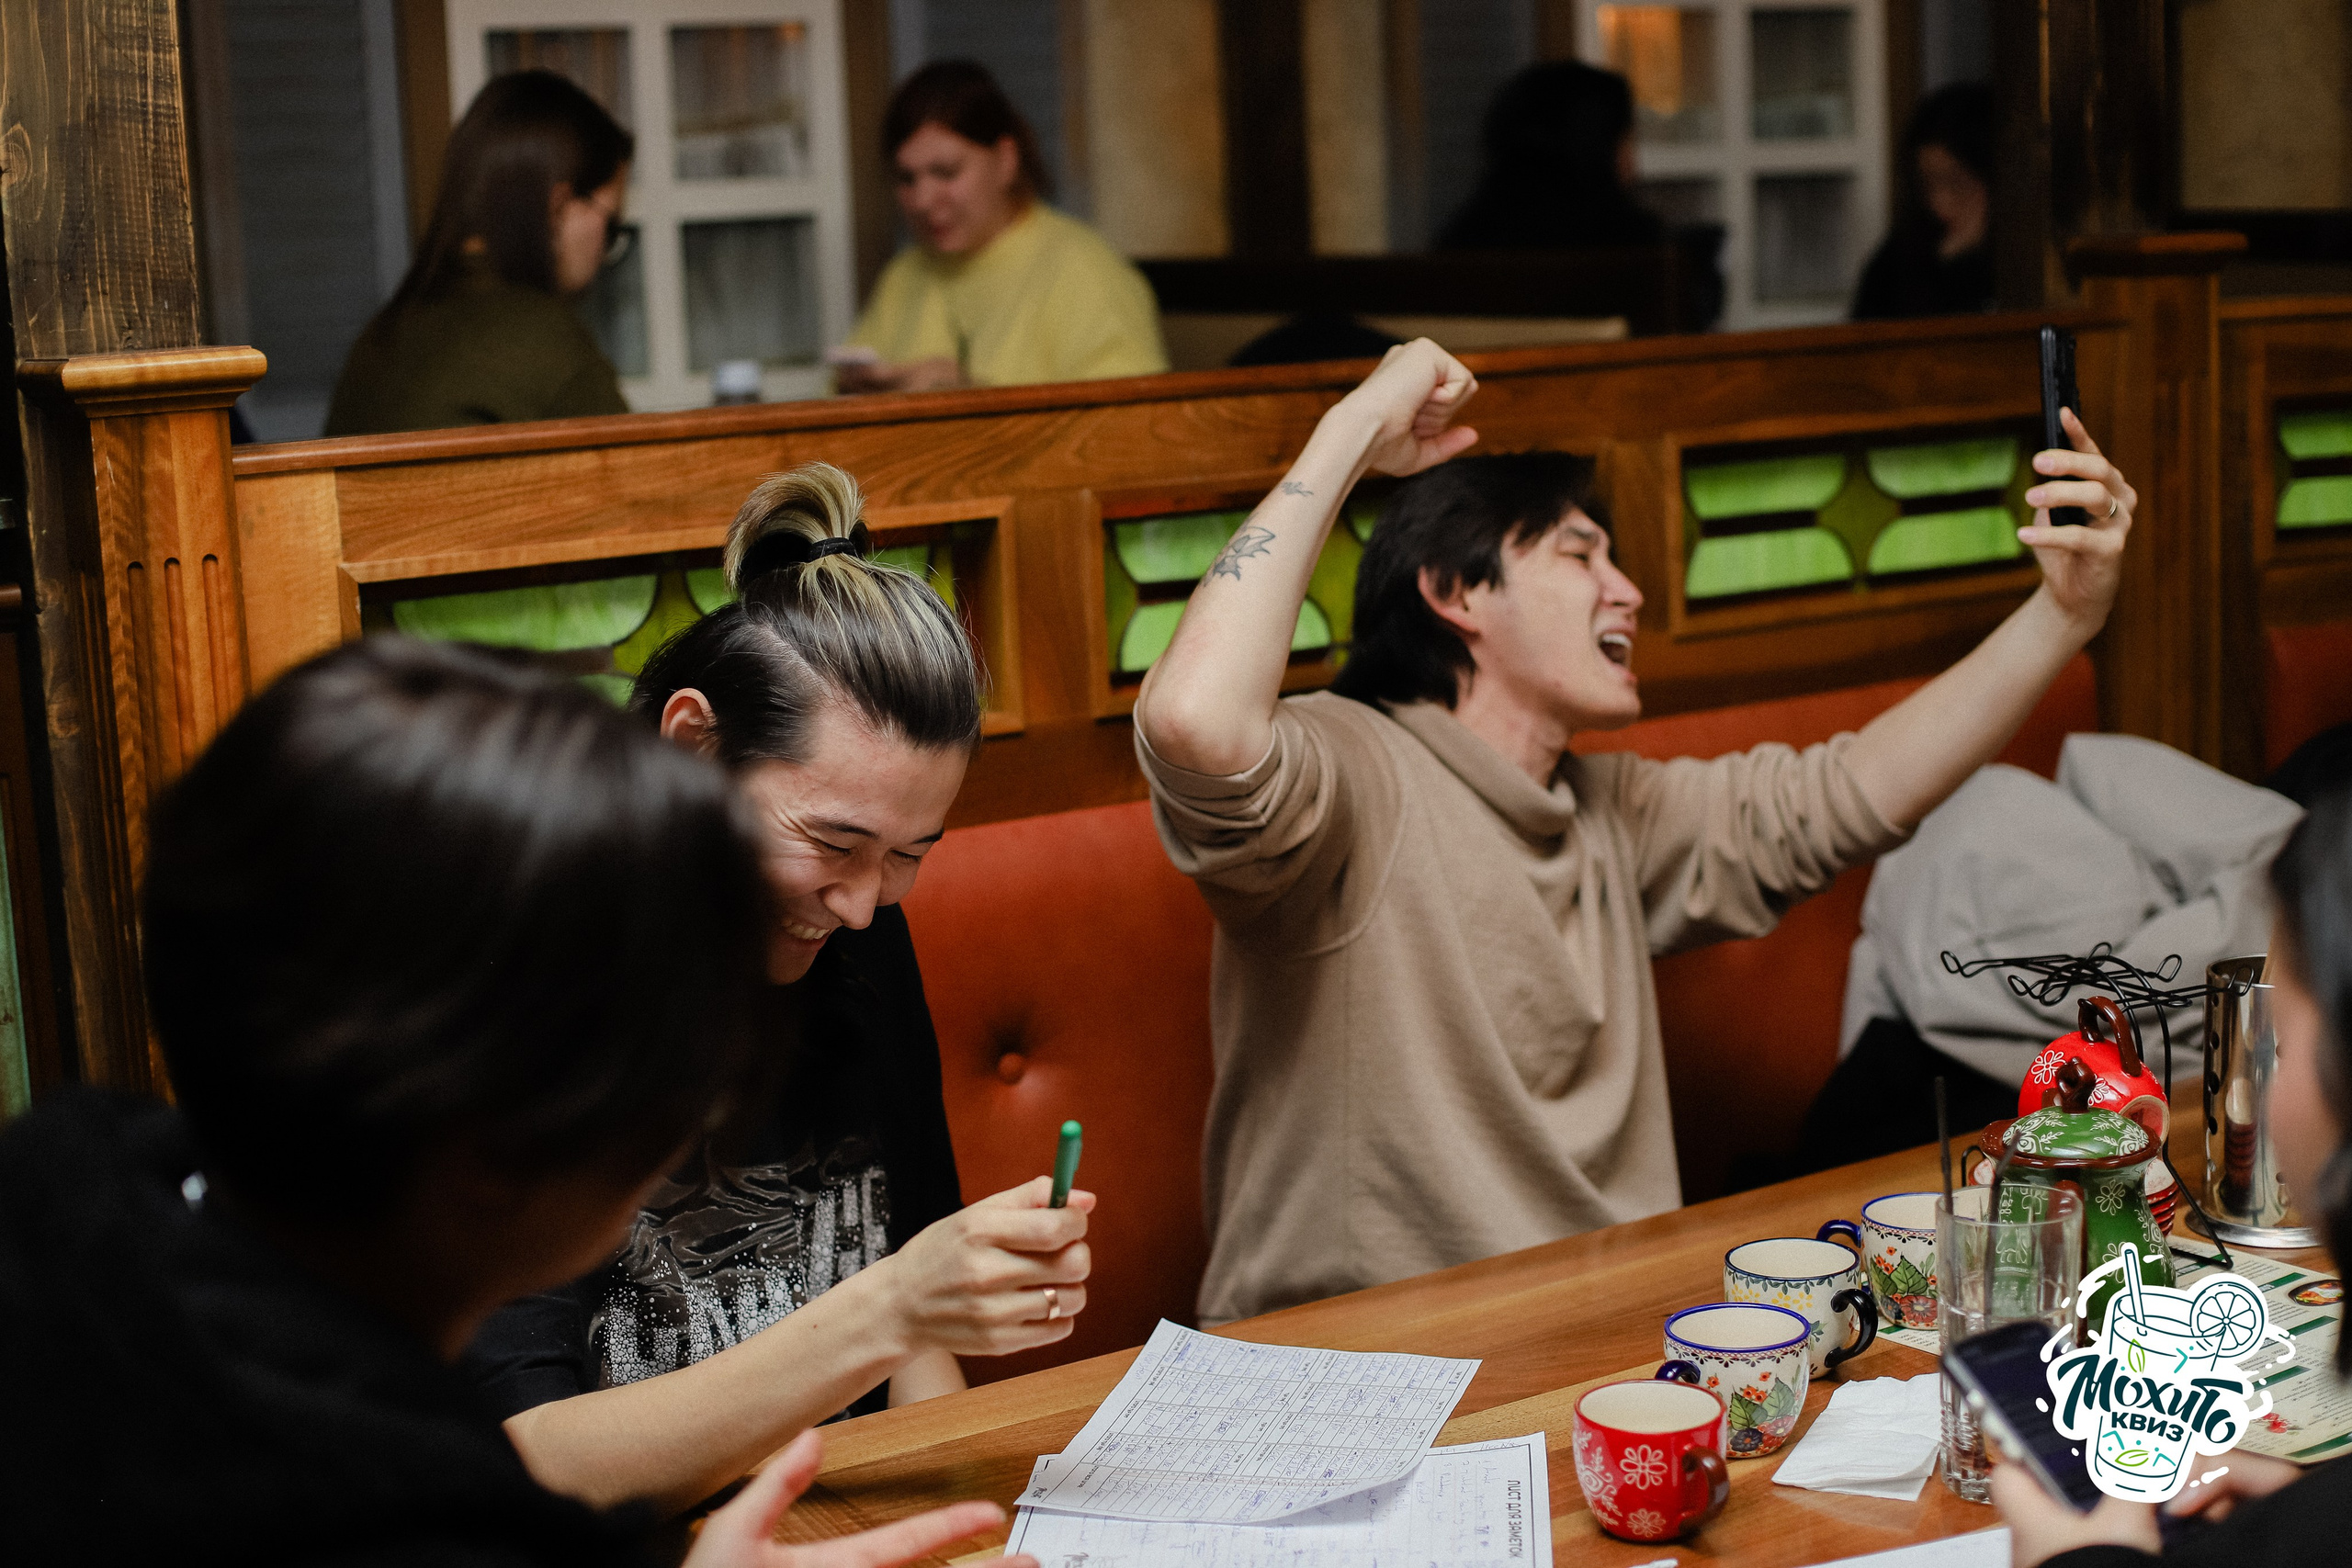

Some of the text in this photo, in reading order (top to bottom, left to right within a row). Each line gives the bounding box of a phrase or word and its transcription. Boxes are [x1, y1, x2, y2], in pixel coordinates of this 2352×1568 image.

[1506, 1480, 1522, 1559] ЛИСТ ДЛЯ ЗАМЕТОК
